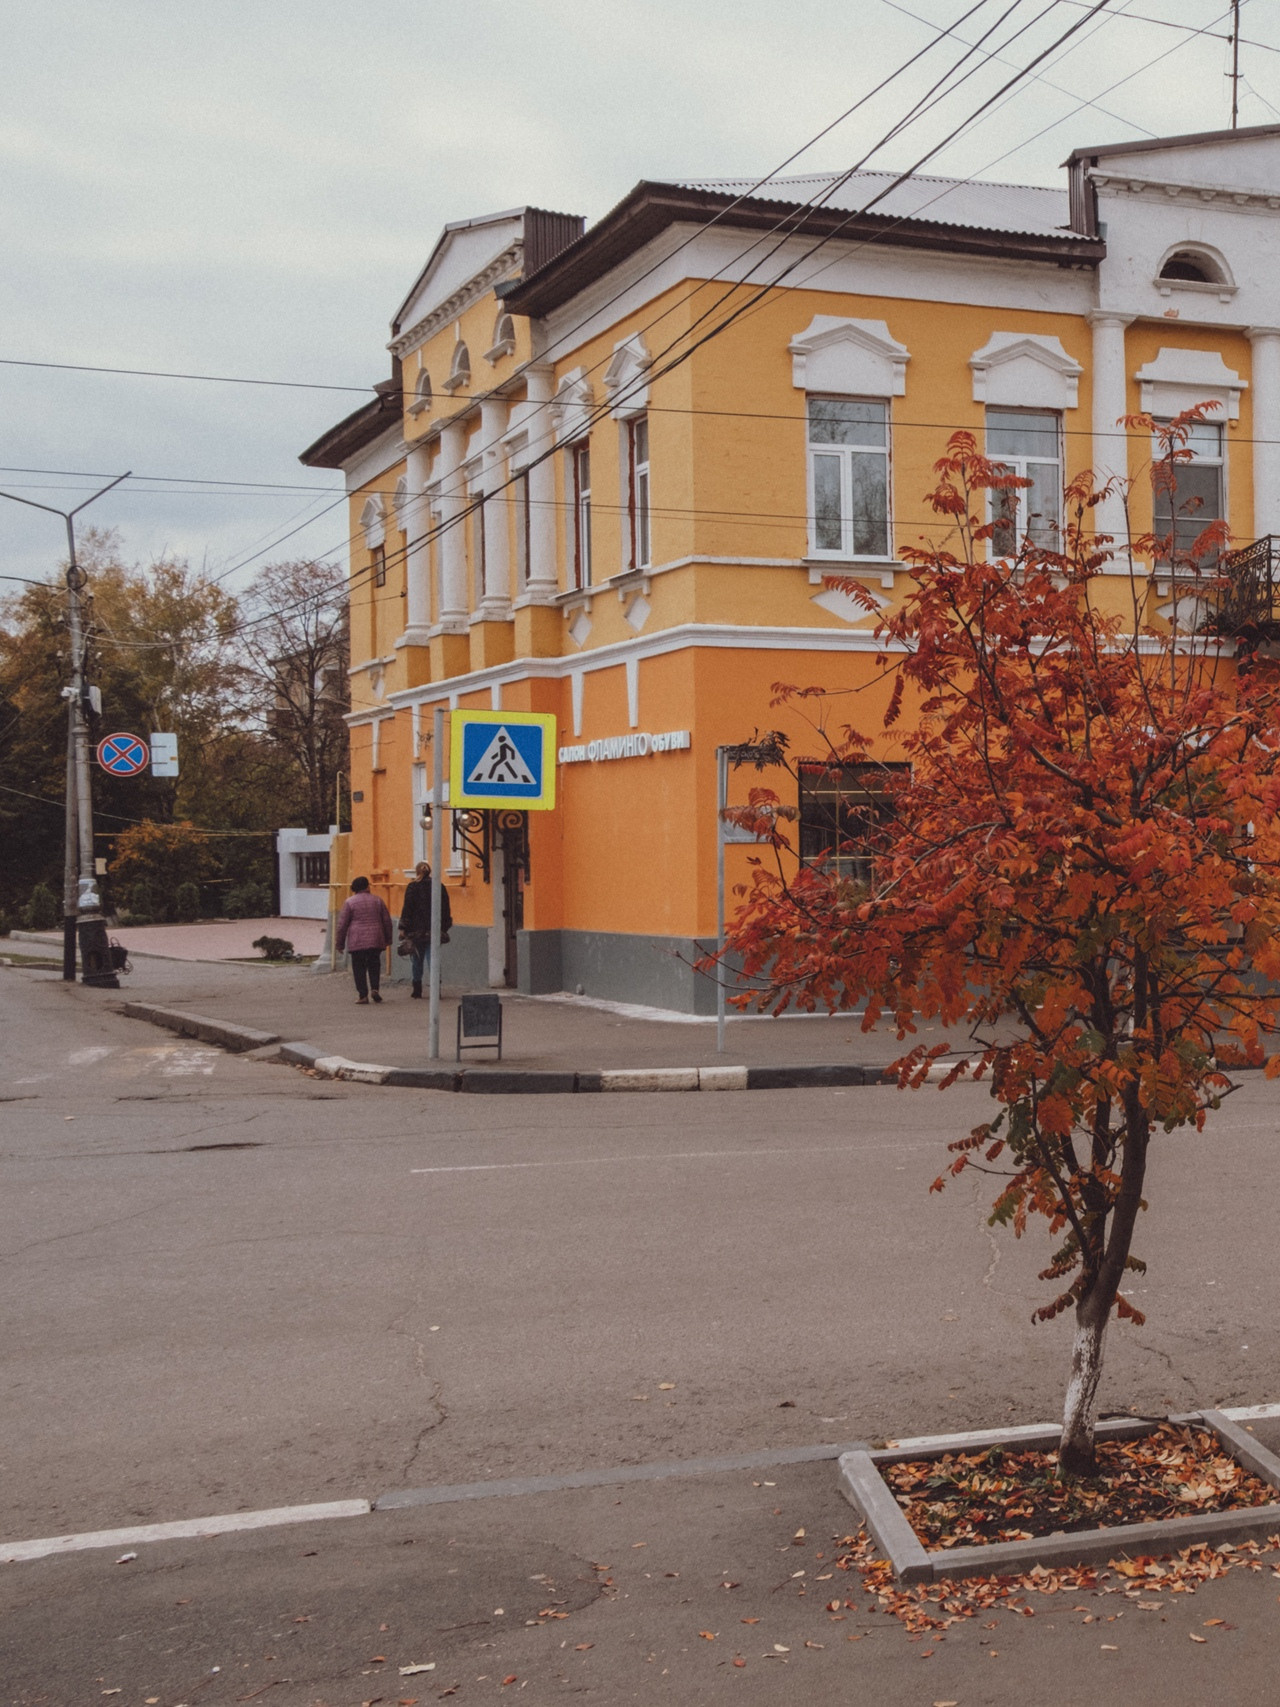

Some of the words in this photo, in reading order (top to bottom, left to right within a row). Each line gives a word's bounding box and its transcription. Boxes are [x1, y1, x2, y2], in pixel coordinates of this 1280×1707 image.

[559, 746, 586, 763] САЛОН
[588, 733, 648, 762] ФЛАМИНГО
[651, 731, 687, 752] ОБУВИ
